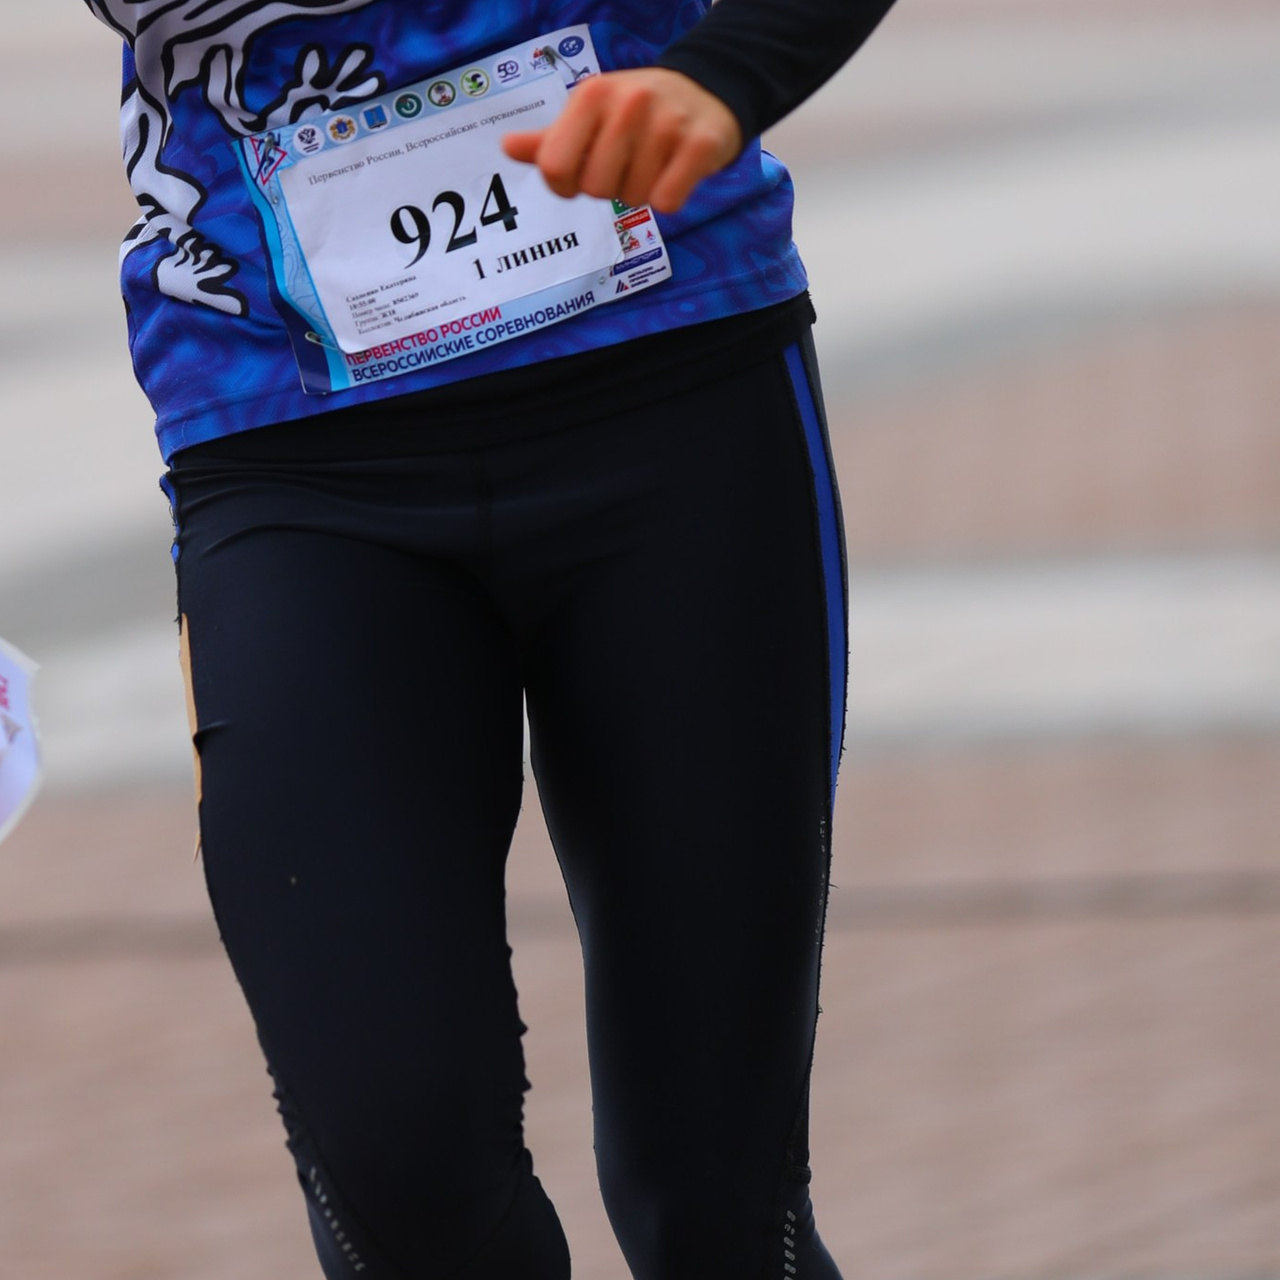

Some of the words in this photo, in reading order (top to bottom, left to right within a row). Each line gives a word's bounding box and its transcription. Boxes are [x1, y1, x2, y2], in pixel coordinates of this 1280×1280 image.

[405, 121, 478, 152] Всероссийские
[390, 172, 519, 269] 924
[472, 258, 486, 280] 1
[345, 328, 439, 366] ПЕРВЕНСТВО
[440, 306, 502, 338] РОССИИ
[476, 290, 596, 347] СОРЕВНОВАНИЯ
